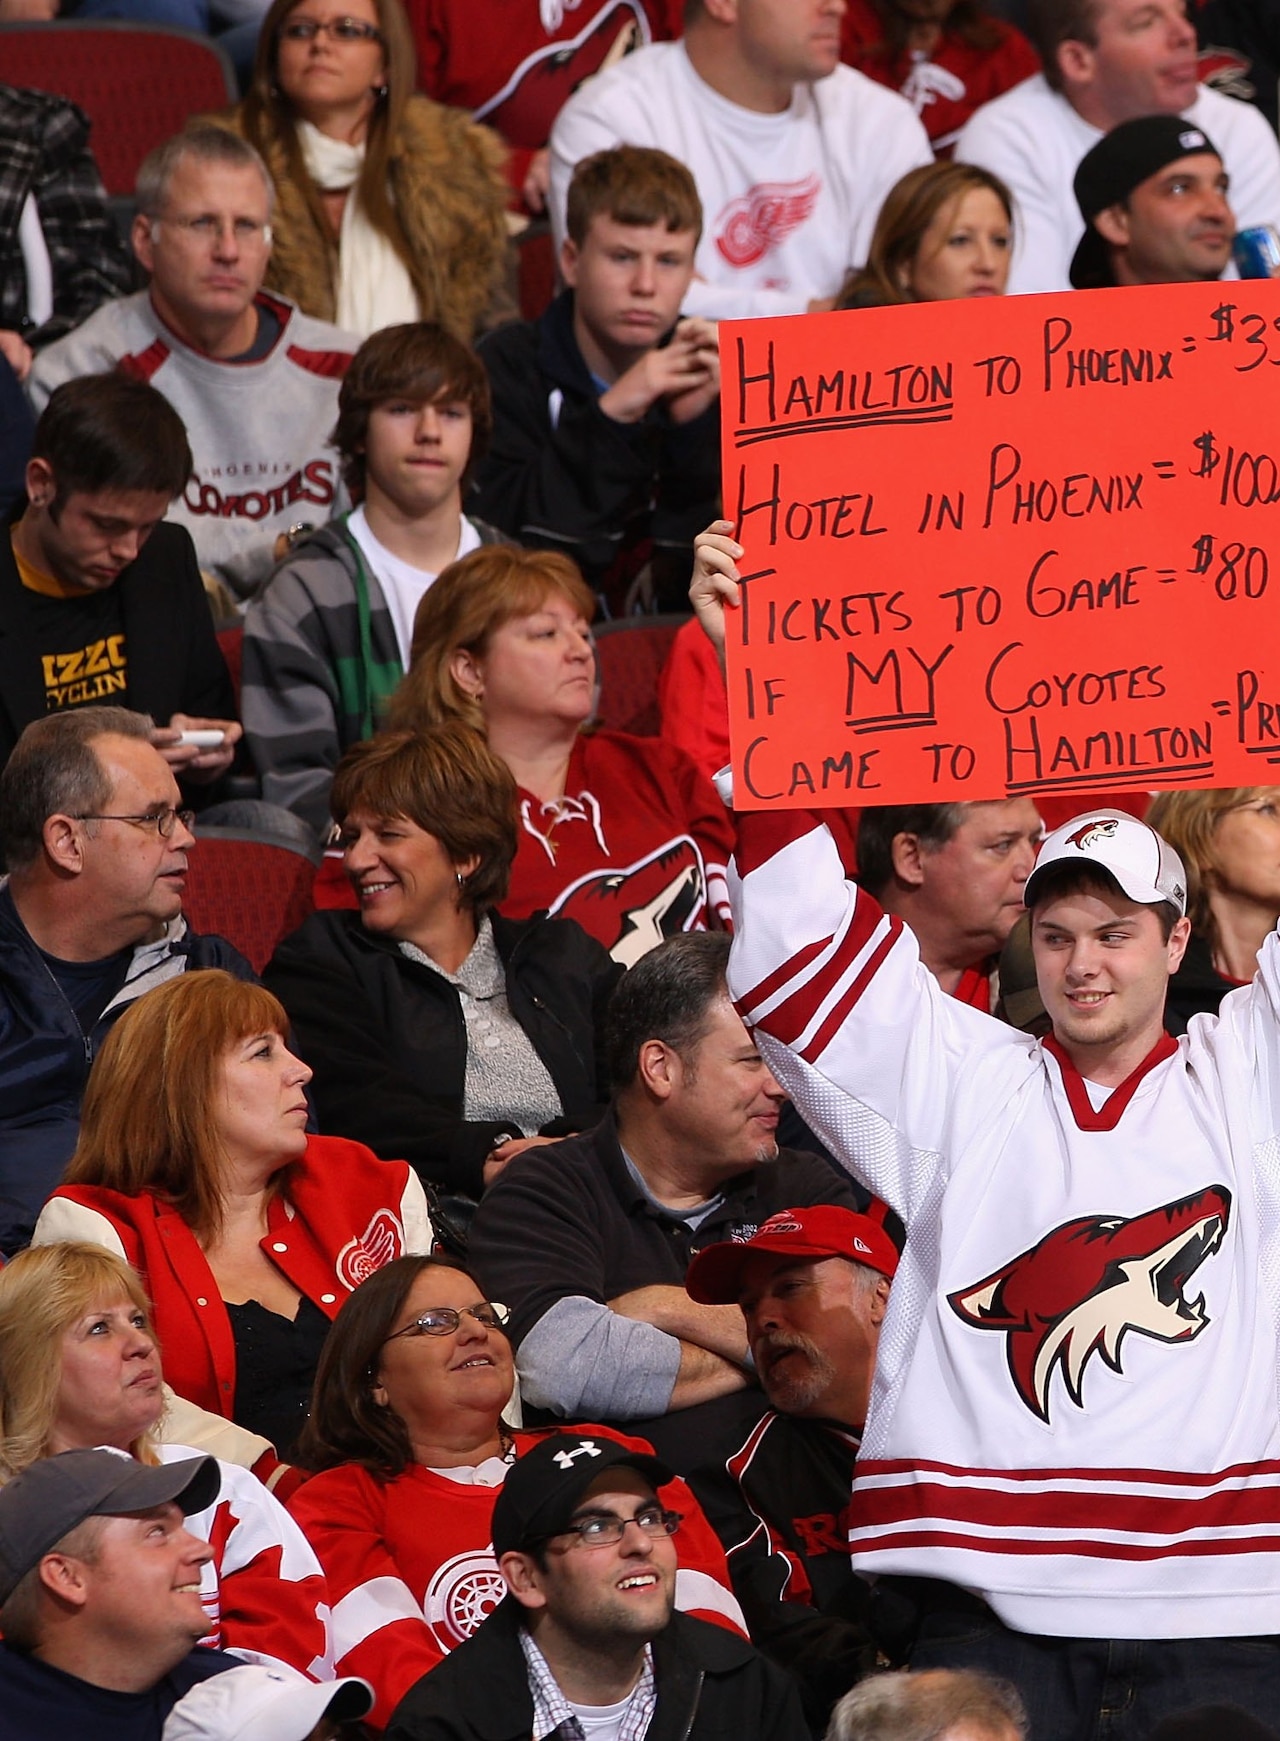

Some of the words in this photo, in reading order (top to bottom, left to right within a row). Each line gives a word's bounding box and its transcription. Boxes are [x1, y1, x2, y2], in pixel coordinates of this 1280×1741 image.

[737, 337, 953, 424] HAMILTON
[974, 356, 1021, 396] TO
[1044, 317, 1173, 391] PHOENIX
[204, 461, 292, 478] HOENIX
[734, 464, 887, 545] HOTEL
[918, 492, 964, 533] IN
[983, 443, 1143, 528] PHOENIX
[737, 569, 912, 645] TICKETS
[939, 586, 1001, 632] TO
[1027, 550, 1147, 617] GAME
[1187, 535, 1268, 600] $80
[46, 670, 127, 709] YCLIN
[746, 668, 784, 719] IF
[846, 644, 954, 715] MY
[986, 642, 1165, 714] COYOTES
[744, 737, 881, 799] CAME
[923, 744, 975, 783] TO
[1003, 716, 1213, 782] HAMILTON
